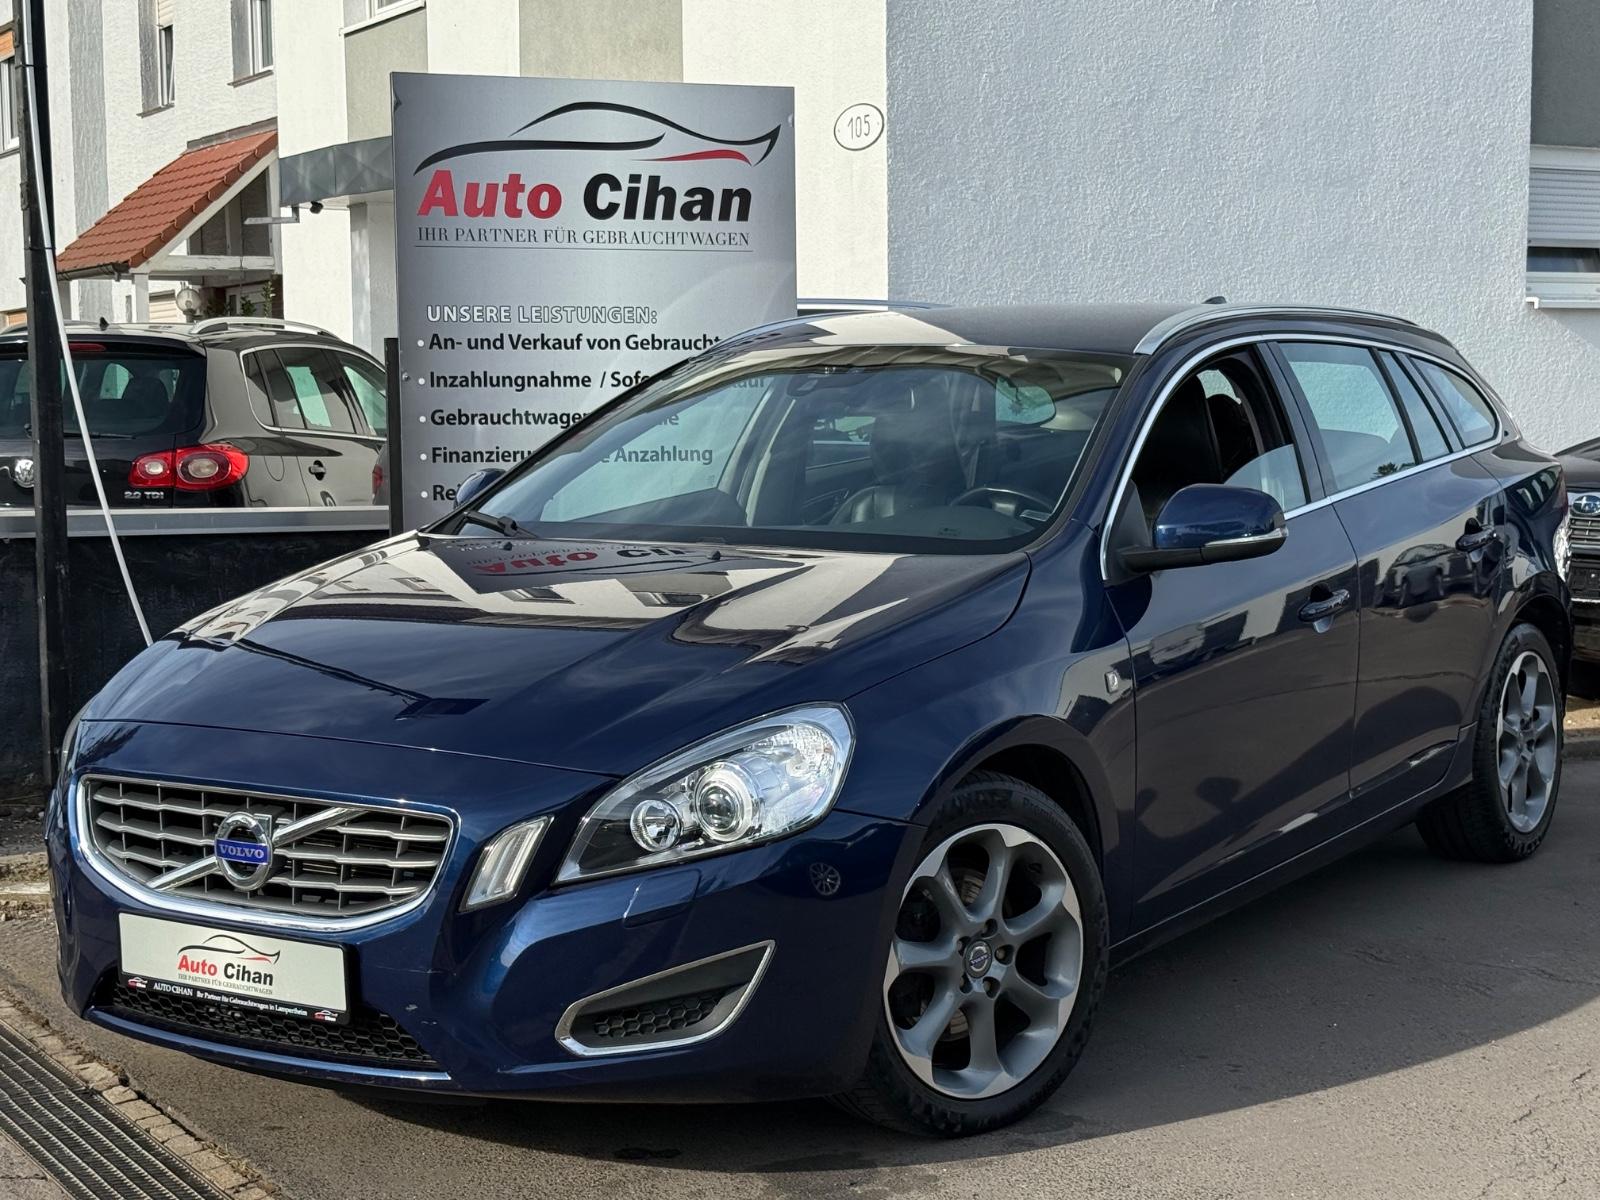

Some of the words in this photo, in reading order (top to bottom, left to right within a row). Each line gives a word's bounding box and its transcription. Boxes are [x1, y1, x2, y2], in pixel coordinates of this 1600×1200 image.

[848, 114, 870, 140] 105
[417, 169, 562, 219] Auto
[583, 173, 753, 222] Cihan
[418, 227, 449, 241] IHR
[455, 228, 538, 243] PARTNER
[543, 226, 578, 244] FÜR
[583, 230, 749, 246] GEBRAUCHTWAGEN
[427, 305, 512, 323] UNSERE
[518, 305, 658, 324] LEISTUNGEN:
[428, 333, 463, 350] An-
[467, 333, 504, 350] und
[508, 333, 583, 350] Verkauf
[586, 338, 621, 350] von
[429, 371, 592, 392] Inzahlungnahme
[600, 371, 606, 388] /
[430, 408, 592, 429] Gebrauchtwage
[431, 446, 536, 463] Finanzieru
[613, 445, 713, 465] Anzahlung
[144, 491, 164, 499] TDI
[218, 843, 264, 859] VOLVO
[178, 955, 217, 976] Auto
[224, 962, 274, 986] Cihan
[153, 982, 171, 992] AUTO
[172, 985, 193, 996] CIHAN
